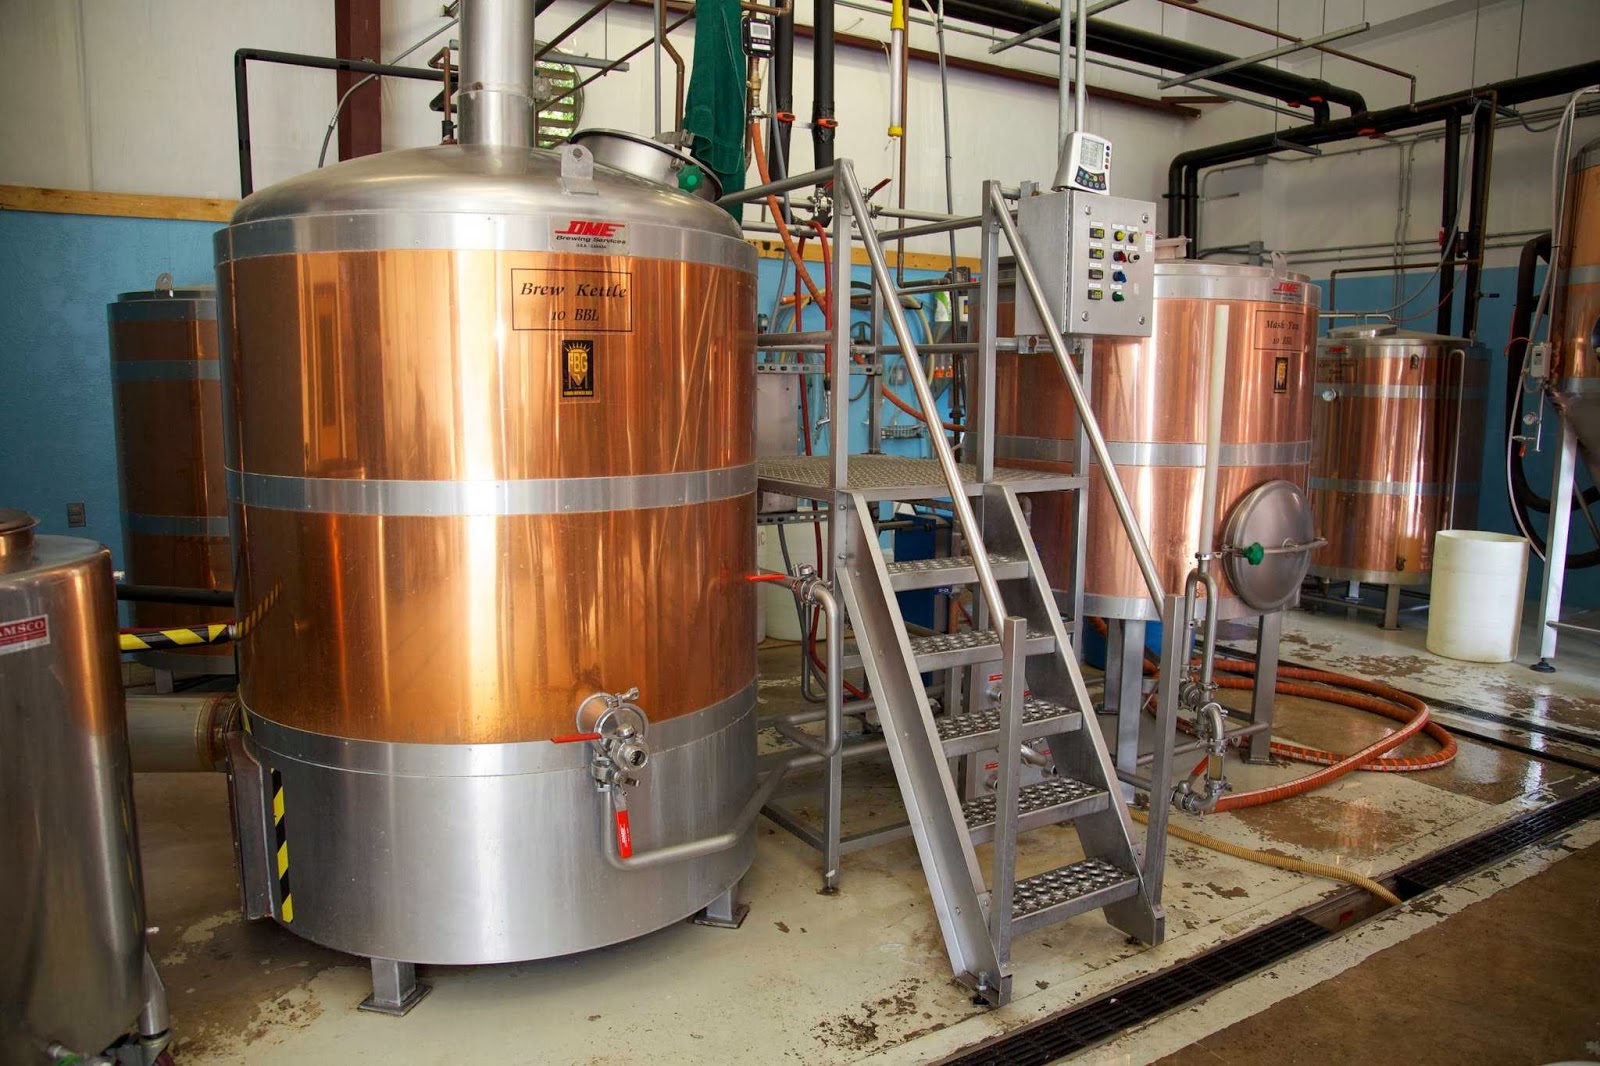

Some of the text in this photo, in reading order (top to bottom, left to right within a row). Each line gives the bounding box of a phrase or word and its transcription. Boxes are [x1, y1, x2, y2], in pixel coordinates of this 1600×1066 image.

[555, 221, 625, 236] DME
[521, 283, 627, 298] Brew Kettle
[551, 309, 599, 321] 10 BBL
